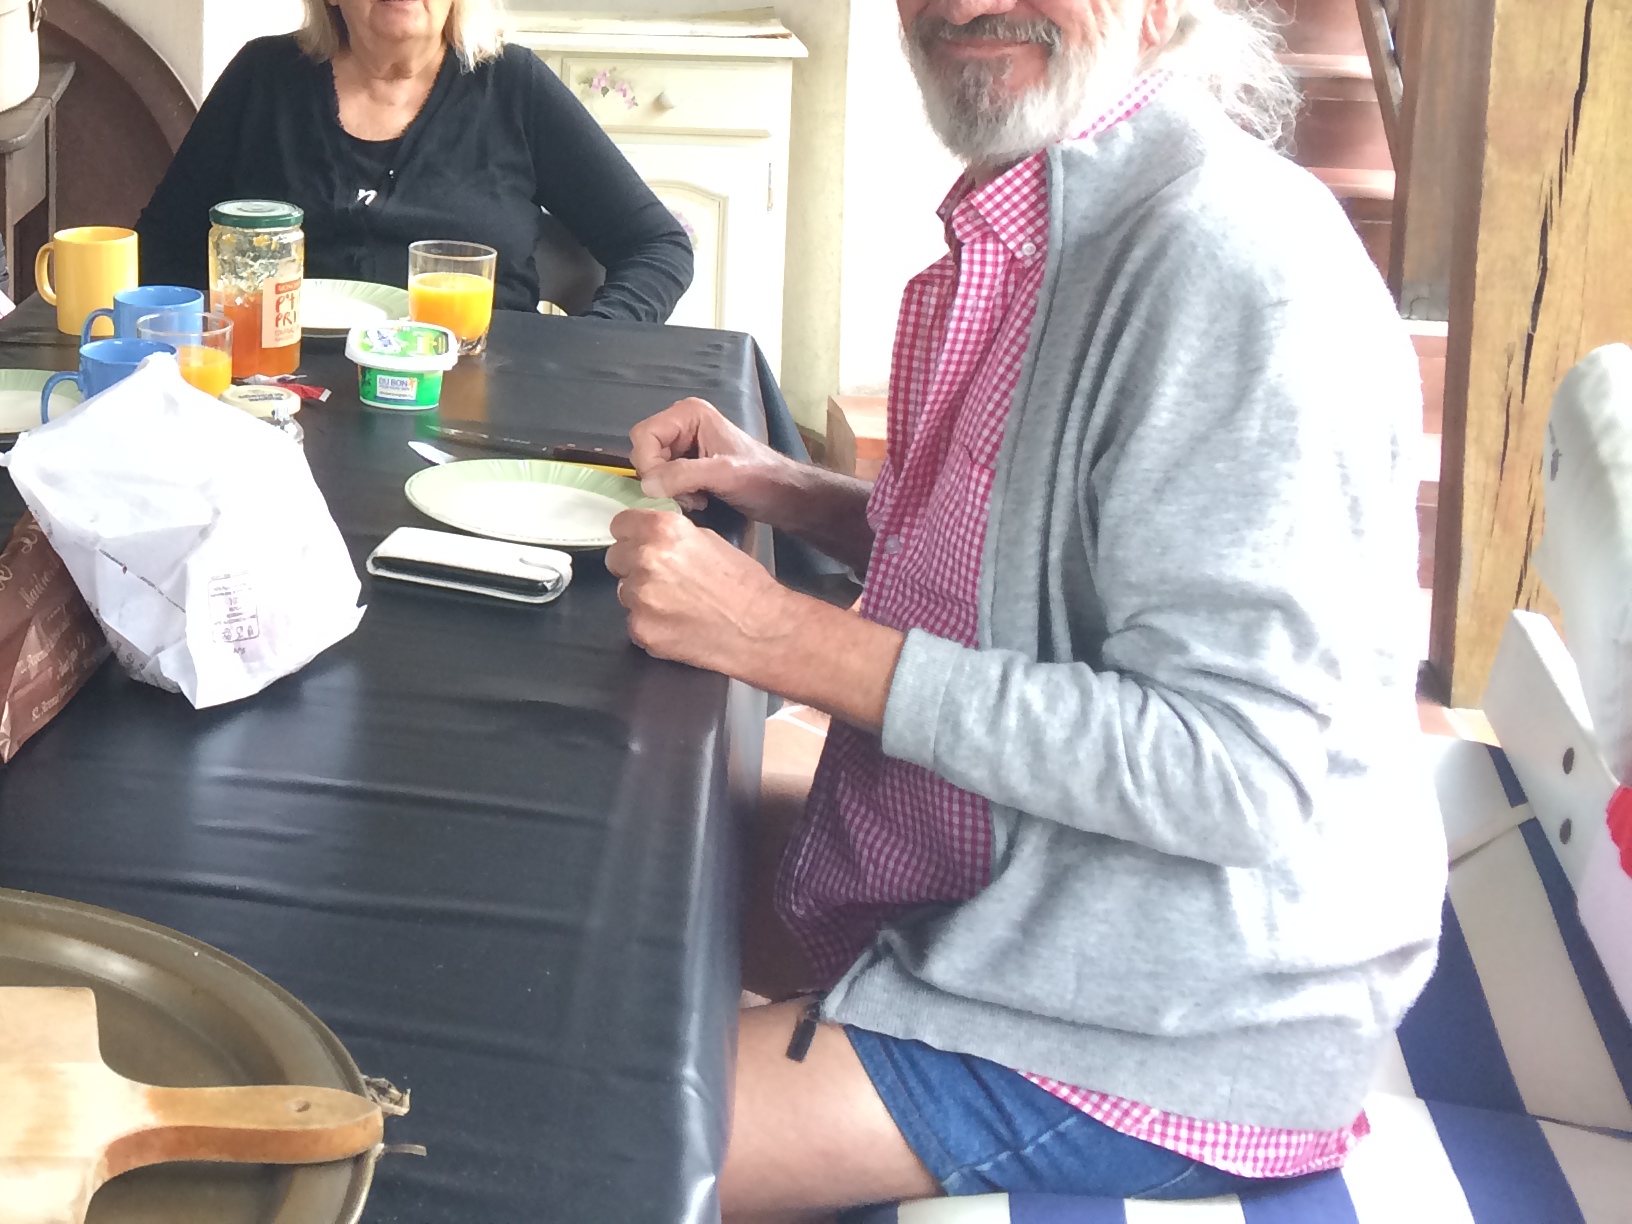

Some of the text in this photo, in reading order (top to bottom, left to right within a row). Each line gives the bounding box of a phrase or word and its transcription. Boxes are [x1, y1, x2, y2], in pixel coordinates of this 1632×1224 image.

[274, 311, 297, 328] PRI
[378, 377, 408, 387] DU BON
